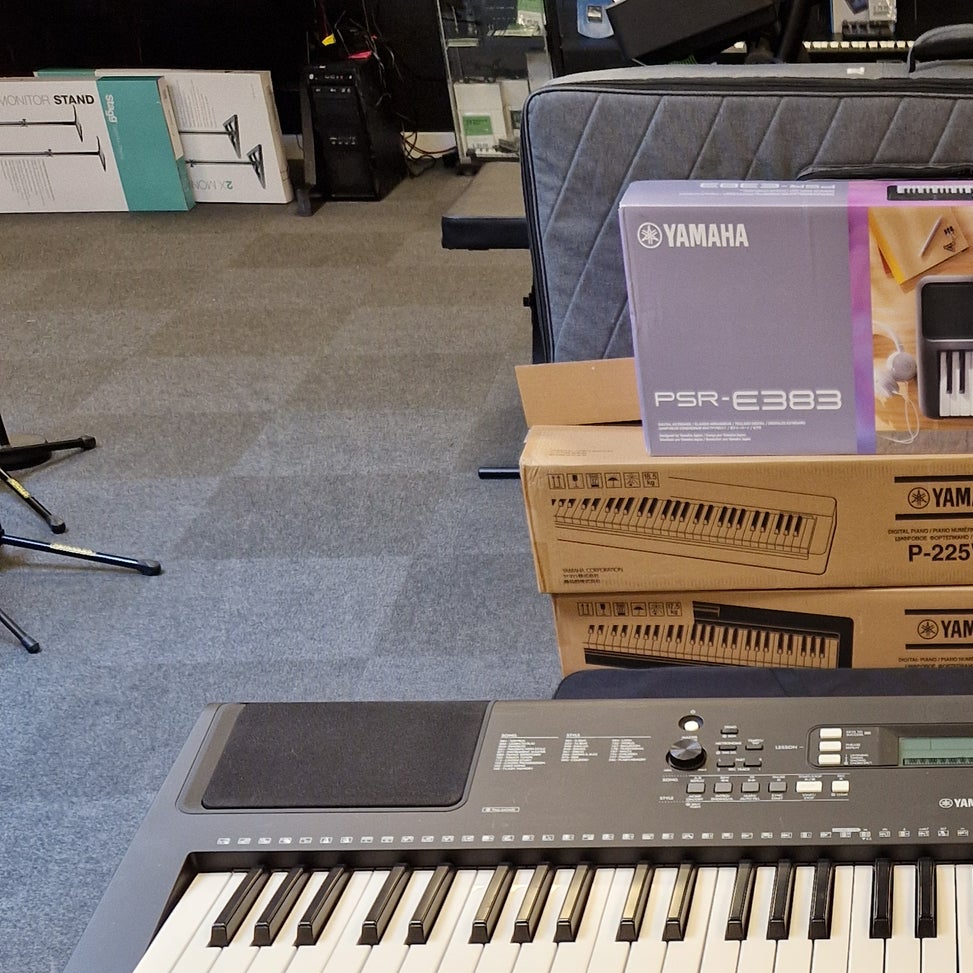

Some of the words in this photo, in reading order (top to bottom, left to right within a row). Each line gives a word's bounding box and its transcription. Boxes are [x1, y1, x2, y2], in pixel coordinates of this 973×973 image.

[53, 94, 95, 105] STAND
[105, 94, 118, 123] stagg
[663, 223, 749, 247] YAMAHA
[654, 390, 842, 411] PSR-E383
